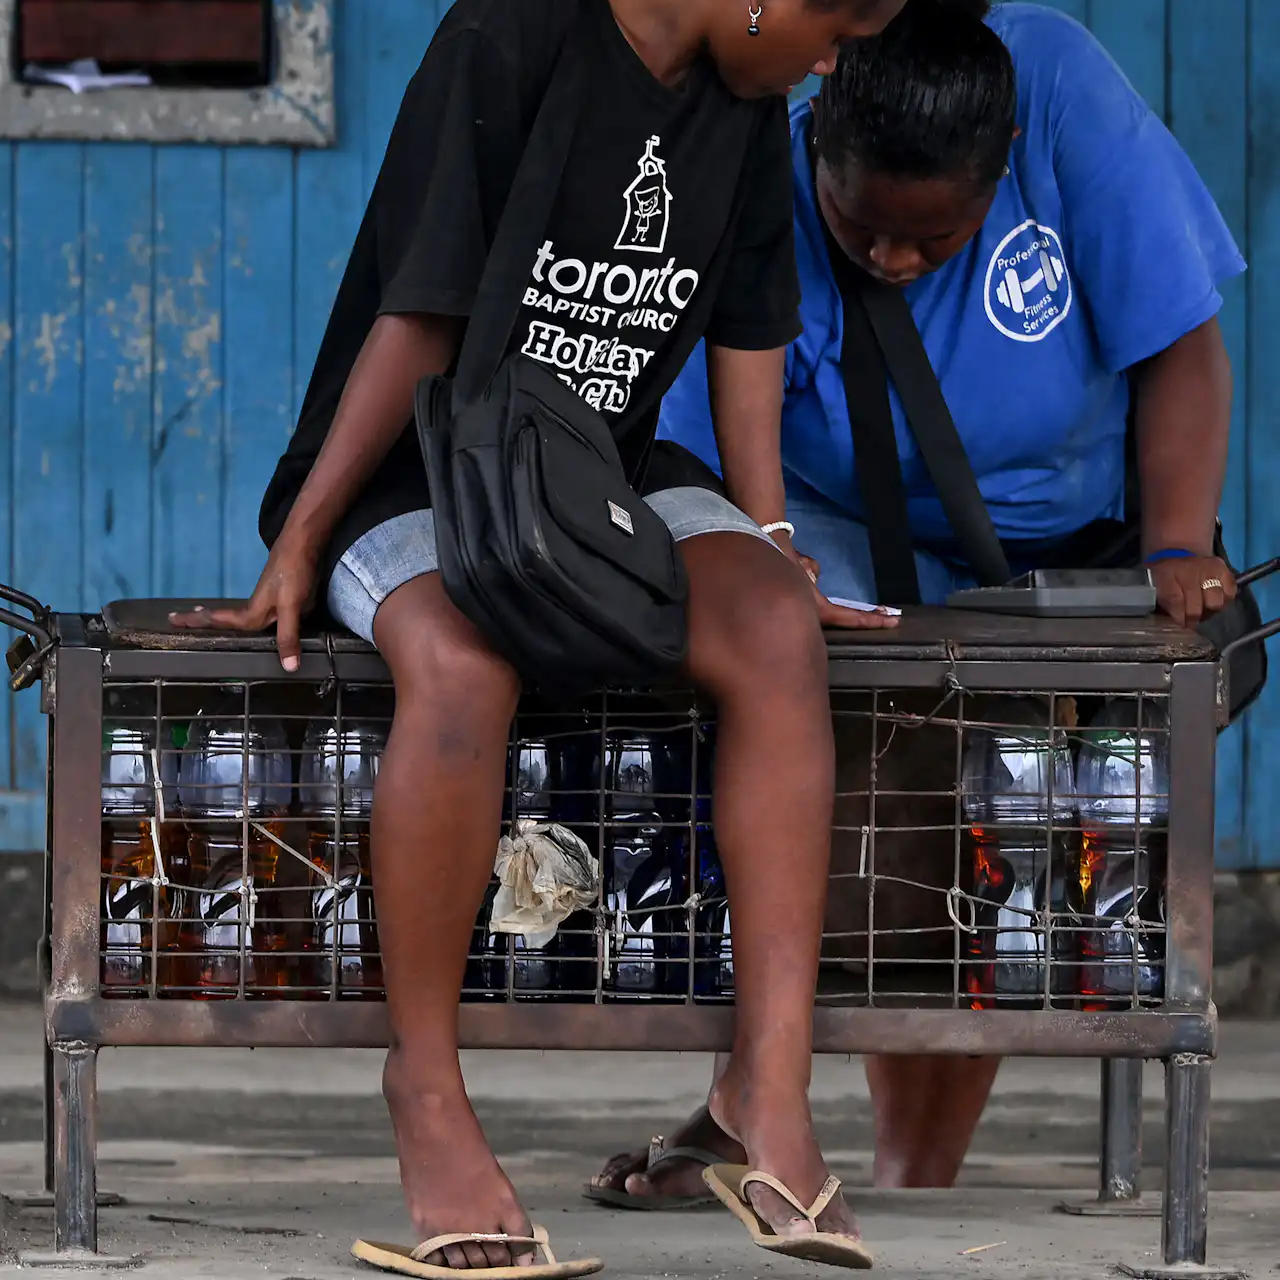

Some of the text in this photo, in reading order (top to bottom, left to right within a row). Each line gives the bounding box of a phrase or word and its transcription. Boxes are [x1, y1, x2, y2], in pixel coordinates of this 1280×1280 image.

[532, 240, 699, 310] toronto
[521, 287, 616, 327] BAPTIST
[1023, 293, 1053, 320] Fitness
